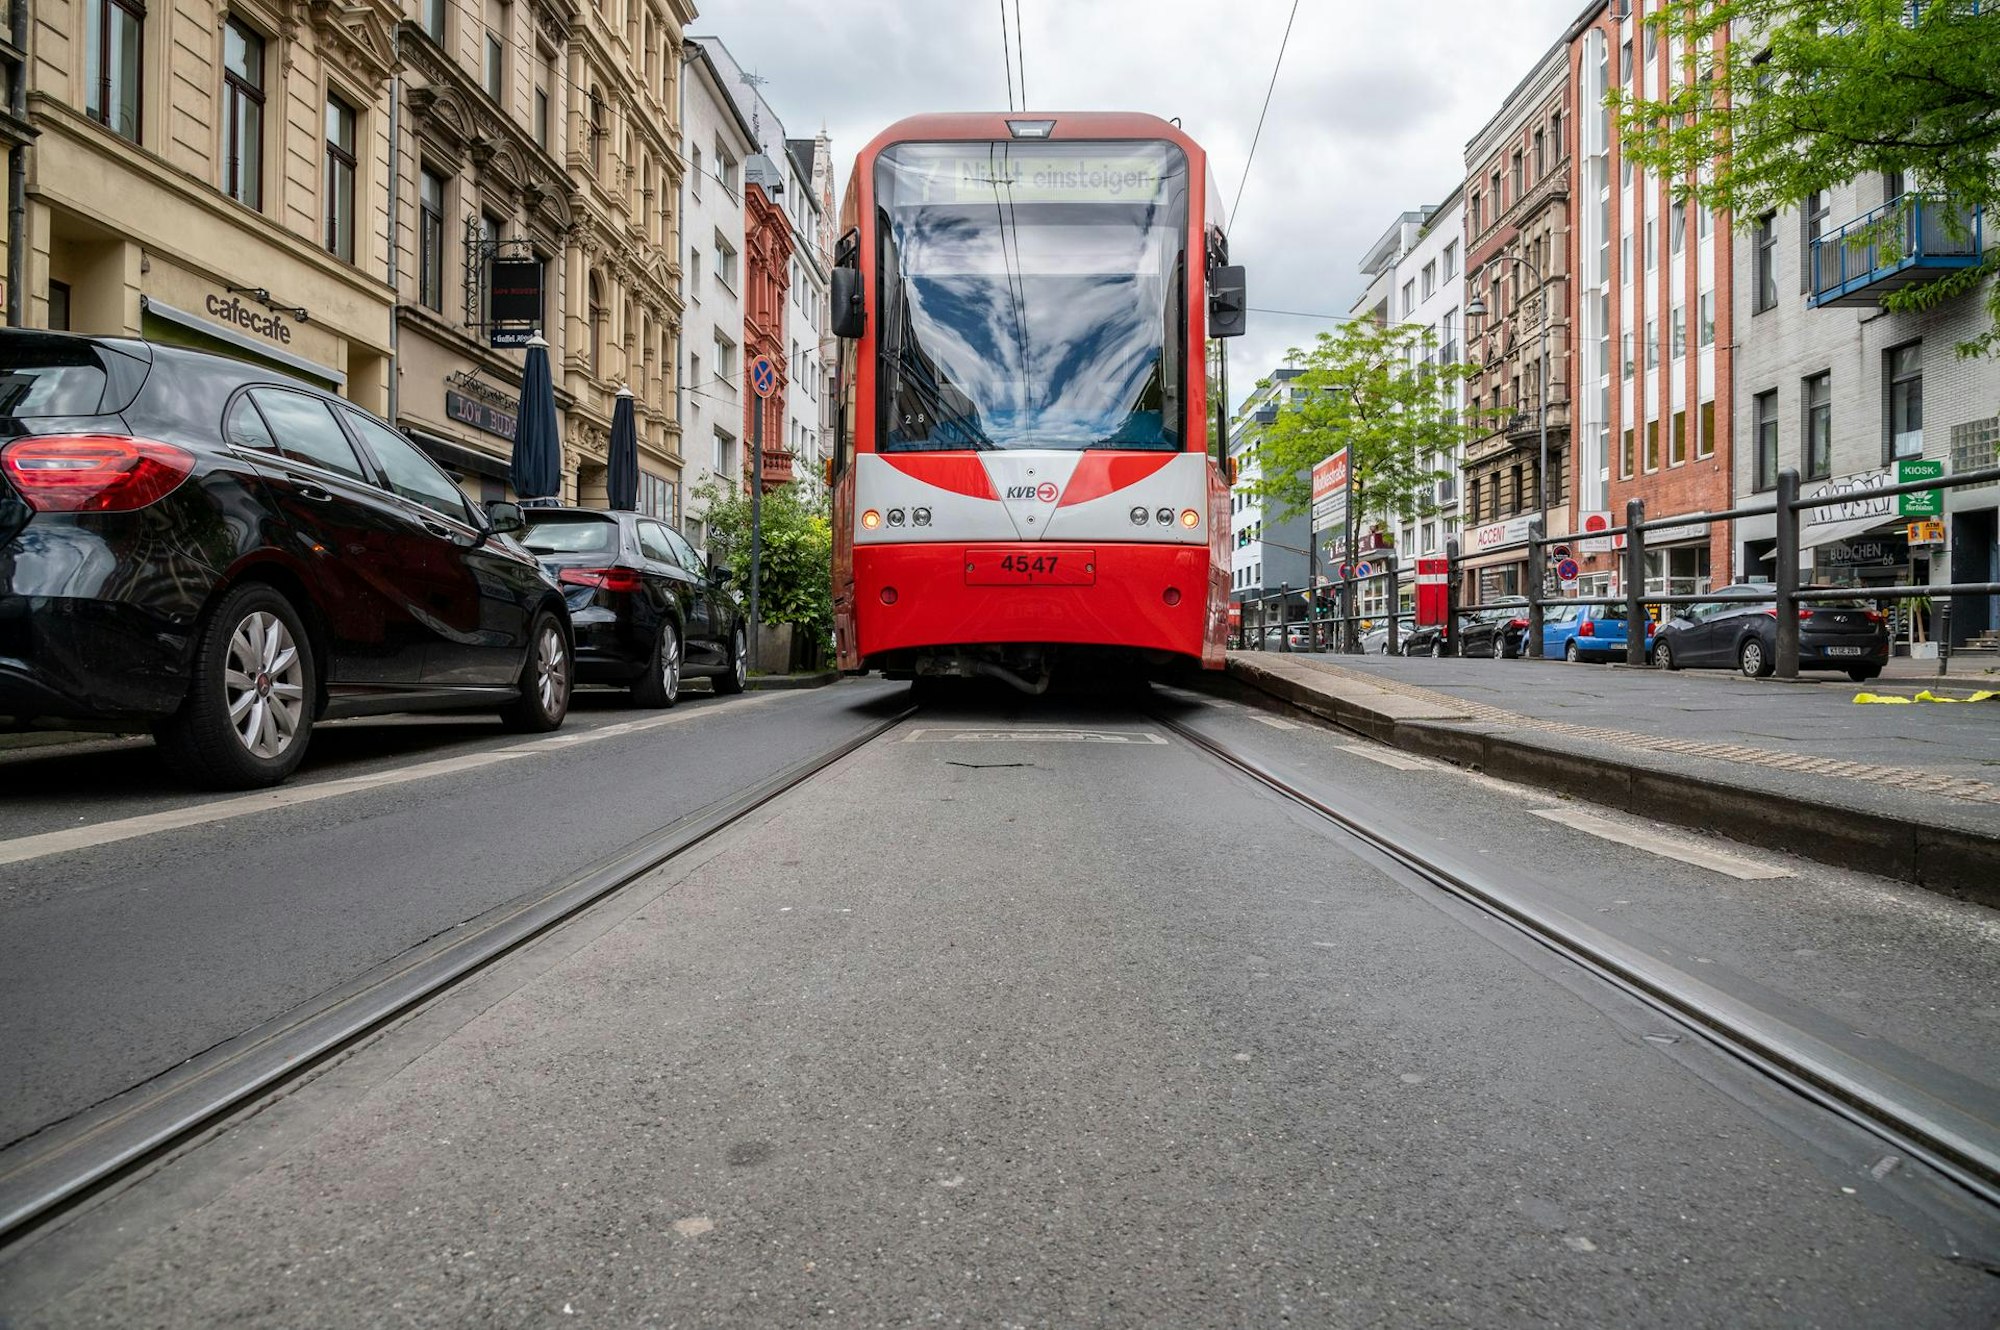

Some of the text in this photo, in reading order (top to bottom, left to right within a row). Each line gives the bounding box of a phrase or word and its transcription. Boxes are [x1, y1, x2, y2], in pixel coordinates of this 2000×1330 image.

[1032, 159, 1149, 194] einsteigen
[206, 294, 291, 345] cafecafe
[457, 397, 518, 439] LOW BUDG
[1904, 466, 1934, 475] KIOSK
[1006, 486, 1036, 499] KVB
[1477, 525, 1506, 546] ACCENT
[1001, 555, 1059, 574] 4547
[1883, 553, 1894, 566] 66
